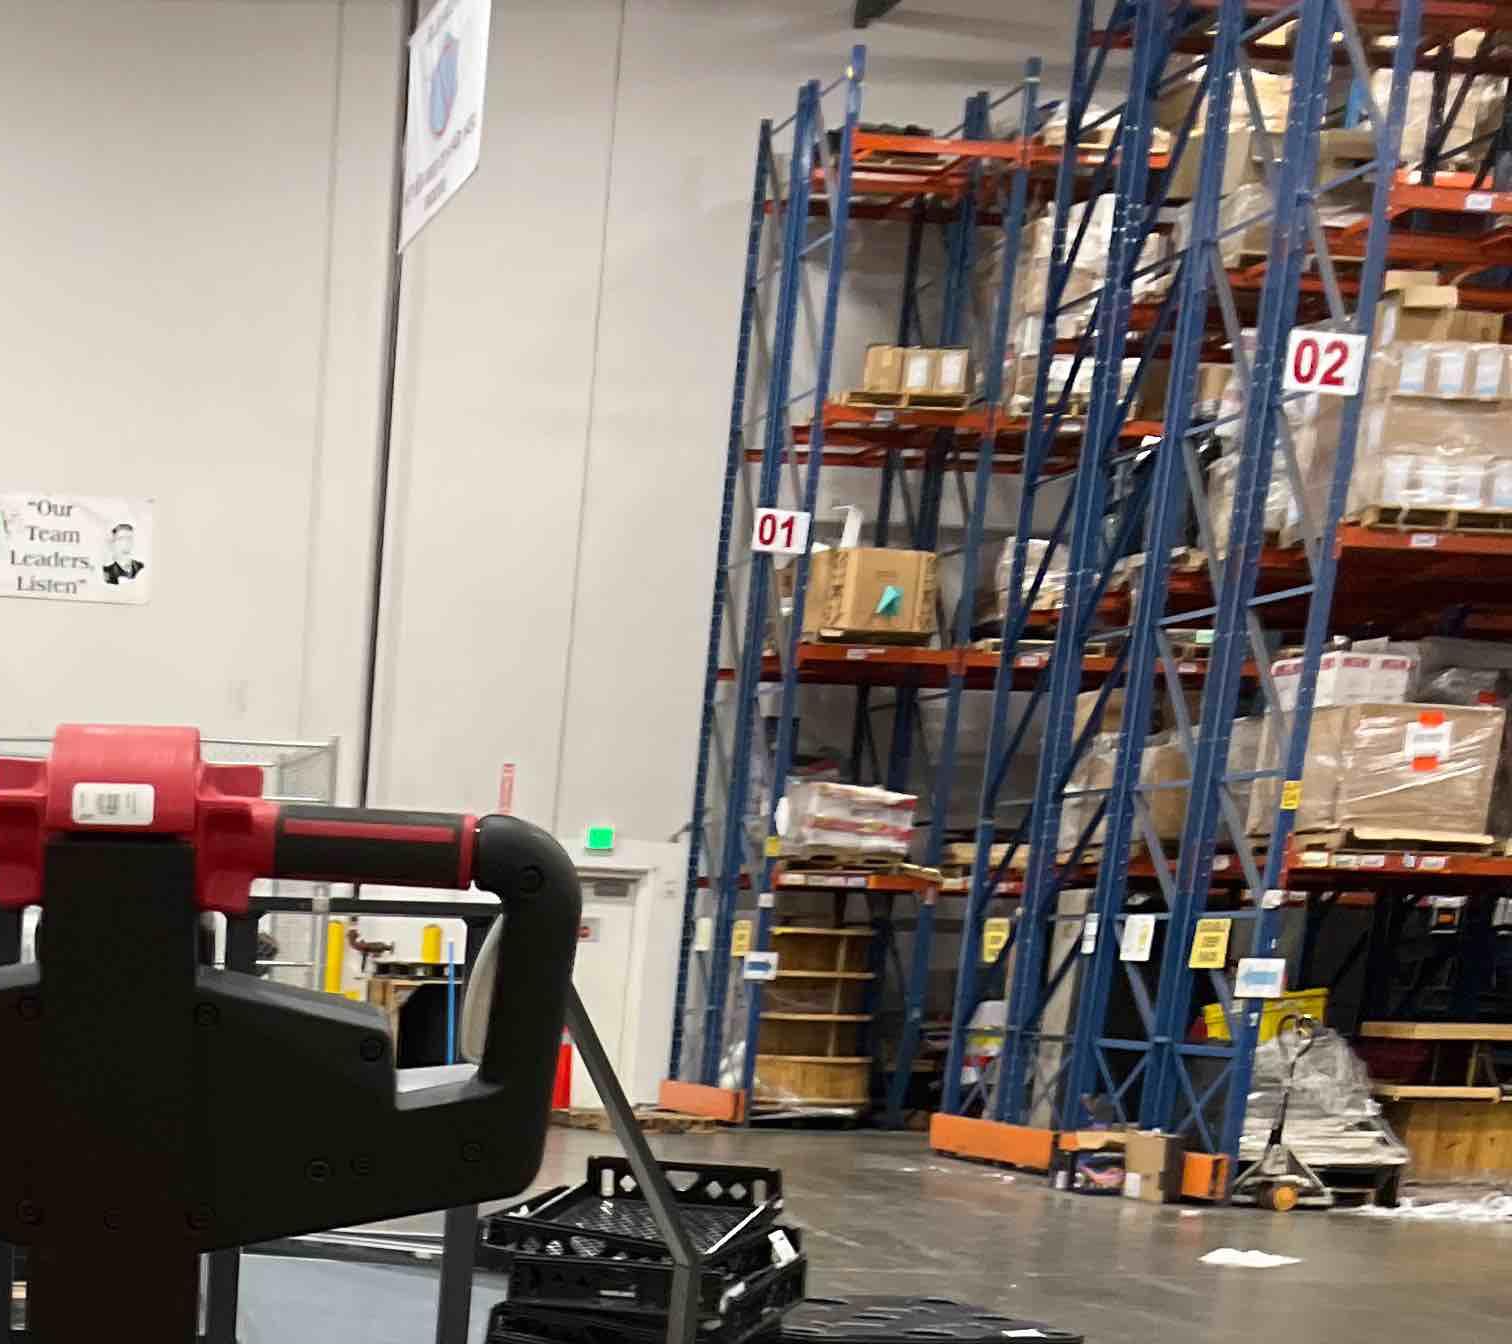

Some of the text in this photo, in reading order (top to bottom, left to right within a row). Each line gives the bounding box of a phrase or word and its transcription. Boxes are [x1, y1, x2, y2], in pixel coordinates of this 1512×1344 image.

[1292, 338, 1349, 386] 02
[24, 525, 81, 544] Team
[759, 514, 795, 548] 01
[9, 549, 95, 571] Leaders,
